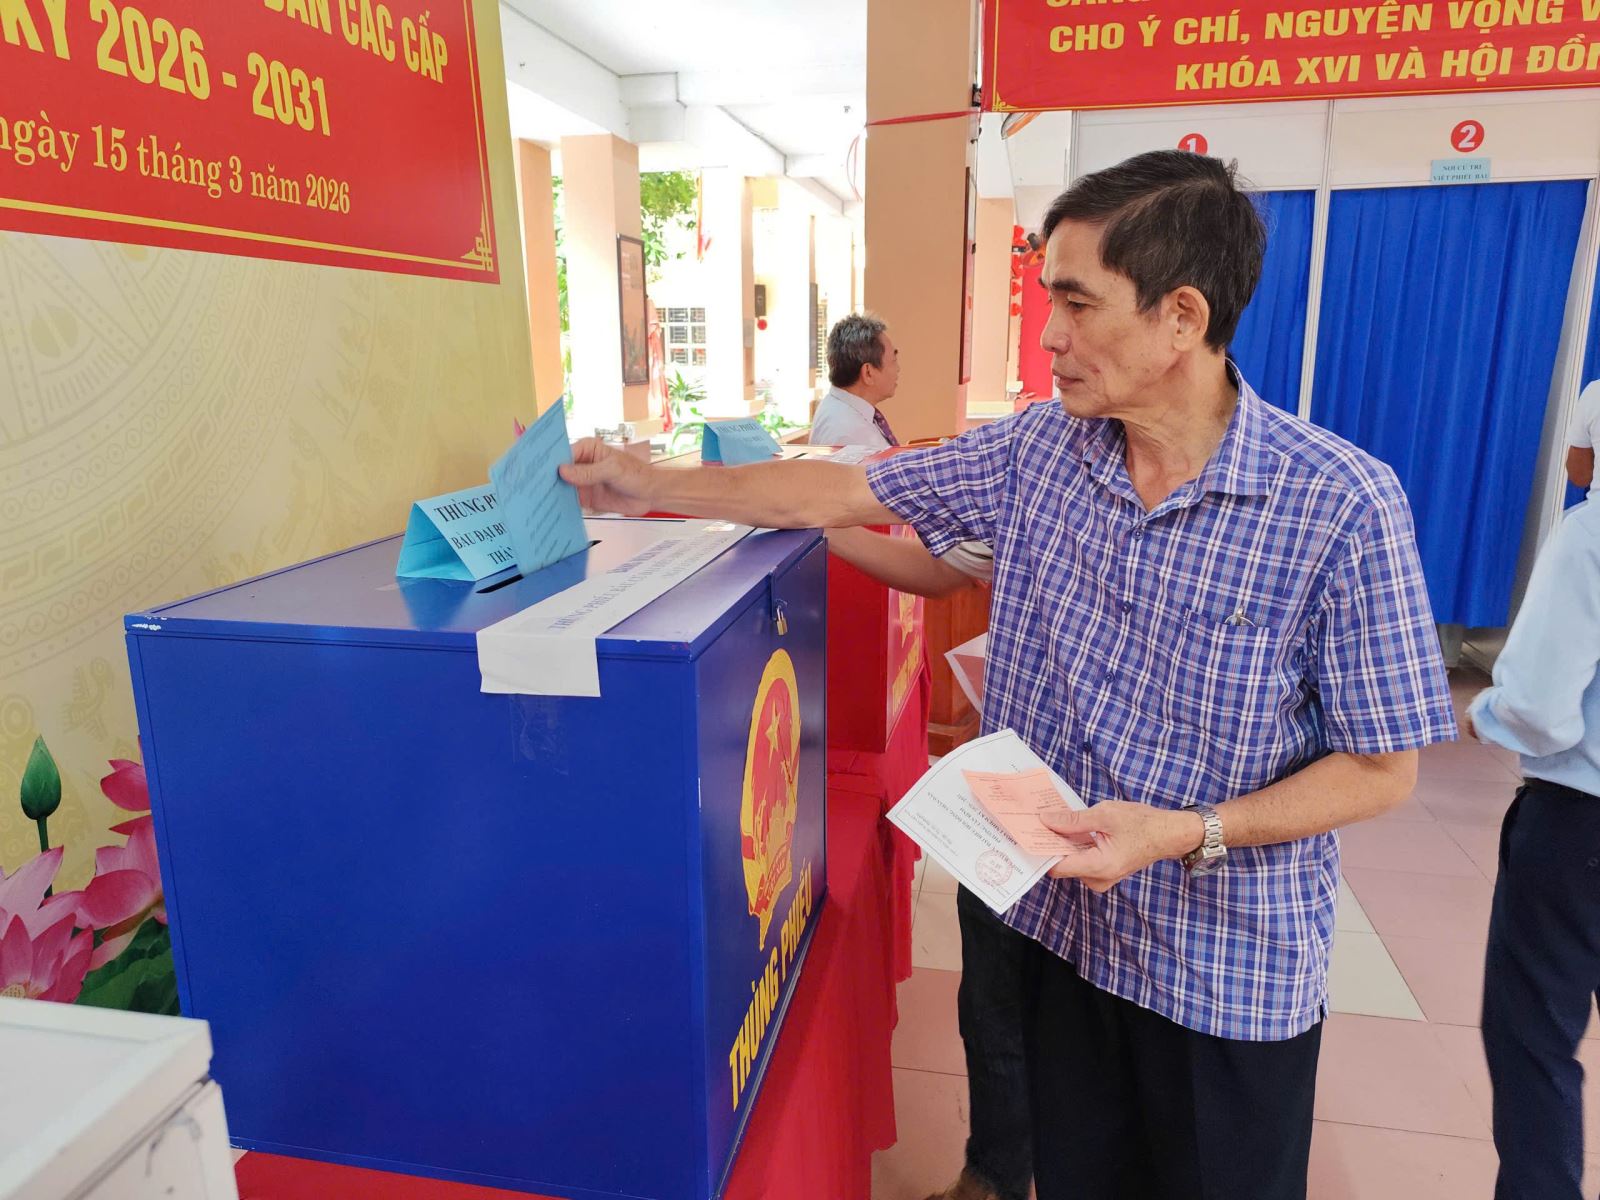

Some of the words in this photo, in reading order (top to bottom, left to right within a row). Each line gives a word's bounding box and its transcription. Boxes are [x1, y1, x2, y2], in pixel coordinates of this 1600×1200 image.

[401, 9, 448, 84] CẤP
[1049, 22, 1125, 53] CHO
[1138, 14, 1162, 47] Ý
[1173, 9, 1250, 45] CHÍ,
[1264, 0, 1433, 40] NGUYỆN
[1447, 0, 1565, 34] VỌNG
[89, 0, 211, 101] 2026
[222, 71, 238, 89] -
[247, 51, 331, 137] 2031
[1175, 54, 1282, 91] KHÓA
[1293, 54, 1361, 86] XVI
[1375, 46, 1427, 81] VÀ
[1440, 42, 1514, 83] HỘI
[1457, 124, 1477, 149] 2
[91, 124, 128, 172] 15
[136, 134, 222, 199] tháng
[228, 155, 243, 194] 3
[250, 163, 302, 205] năm
[305, 173, 351, 215] 2026
[433, 496, 487, 523] THÙNG
[473, 526, 497, 542] ĐẠI
[728, 945, 780, 1114] THÙNG
[780, 856, 813, 984] PHIẾU
